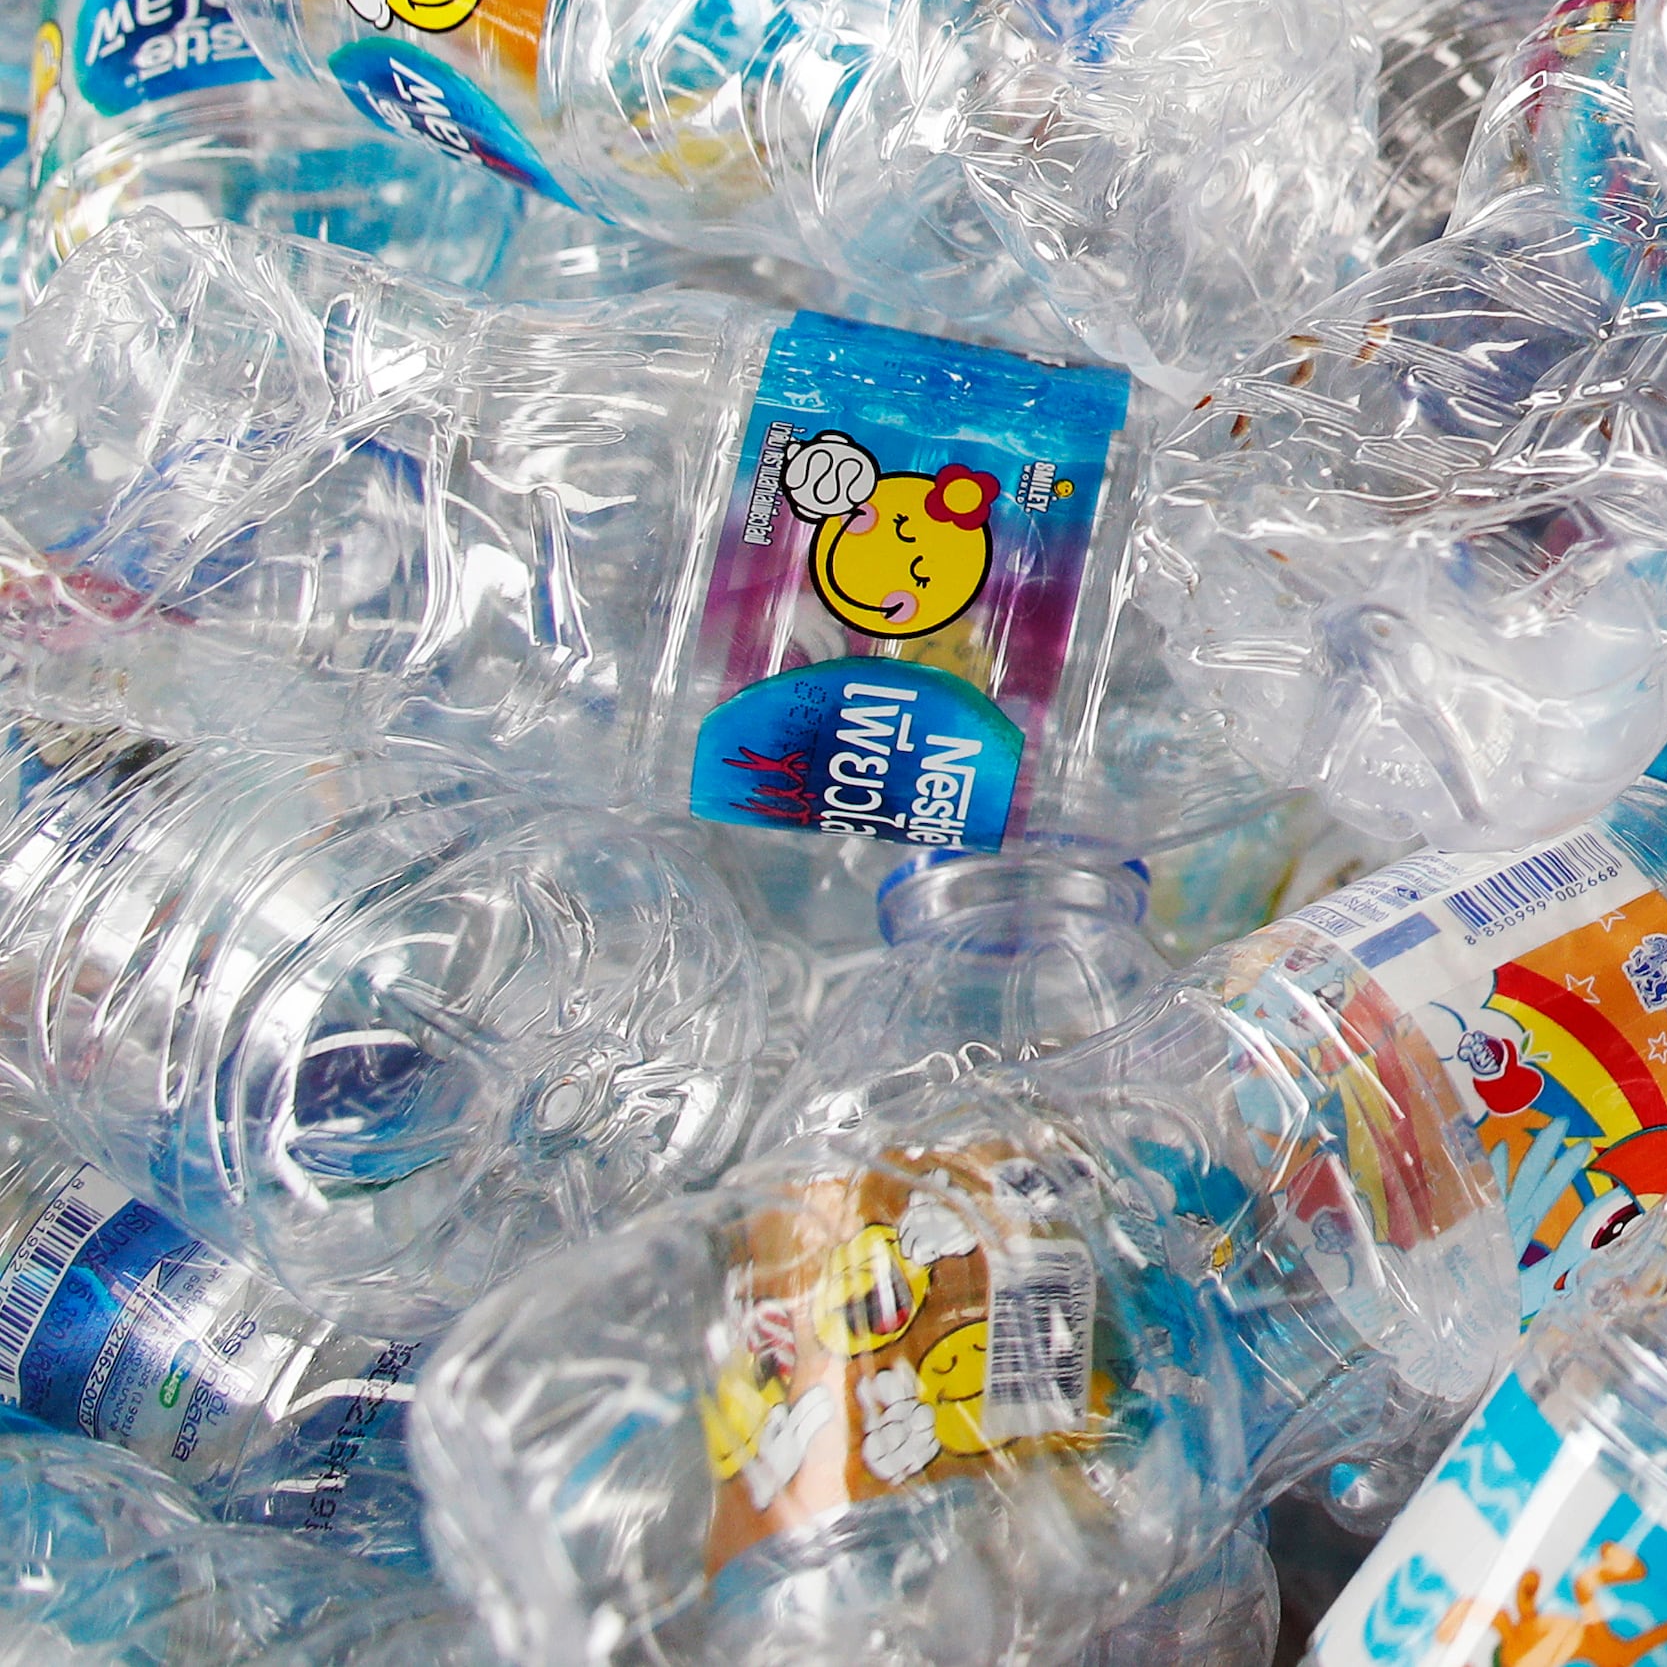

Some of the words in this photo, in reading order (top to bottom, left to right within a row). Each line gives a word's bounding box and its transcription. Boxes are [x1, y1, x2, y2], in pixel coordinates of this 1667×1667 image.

[1016, 464, 1034, 506] WORLD
[819, 681, 918, 841] เพียวไล
[1464, 933, 1477, 946] 8
[1482, 899, 1547, 938] 850999
[1555, 865, 1619, 903] 002668
[70, 1176, 85, 1192] 8
[9, 1198, 66, 1275] 851952
[42, 1298, 80, 1344] 350
[78, 1286, 146, 1424] 4-1-22146-2-0013
[172, 1318, 257, 1464] ตรคริสตัล
